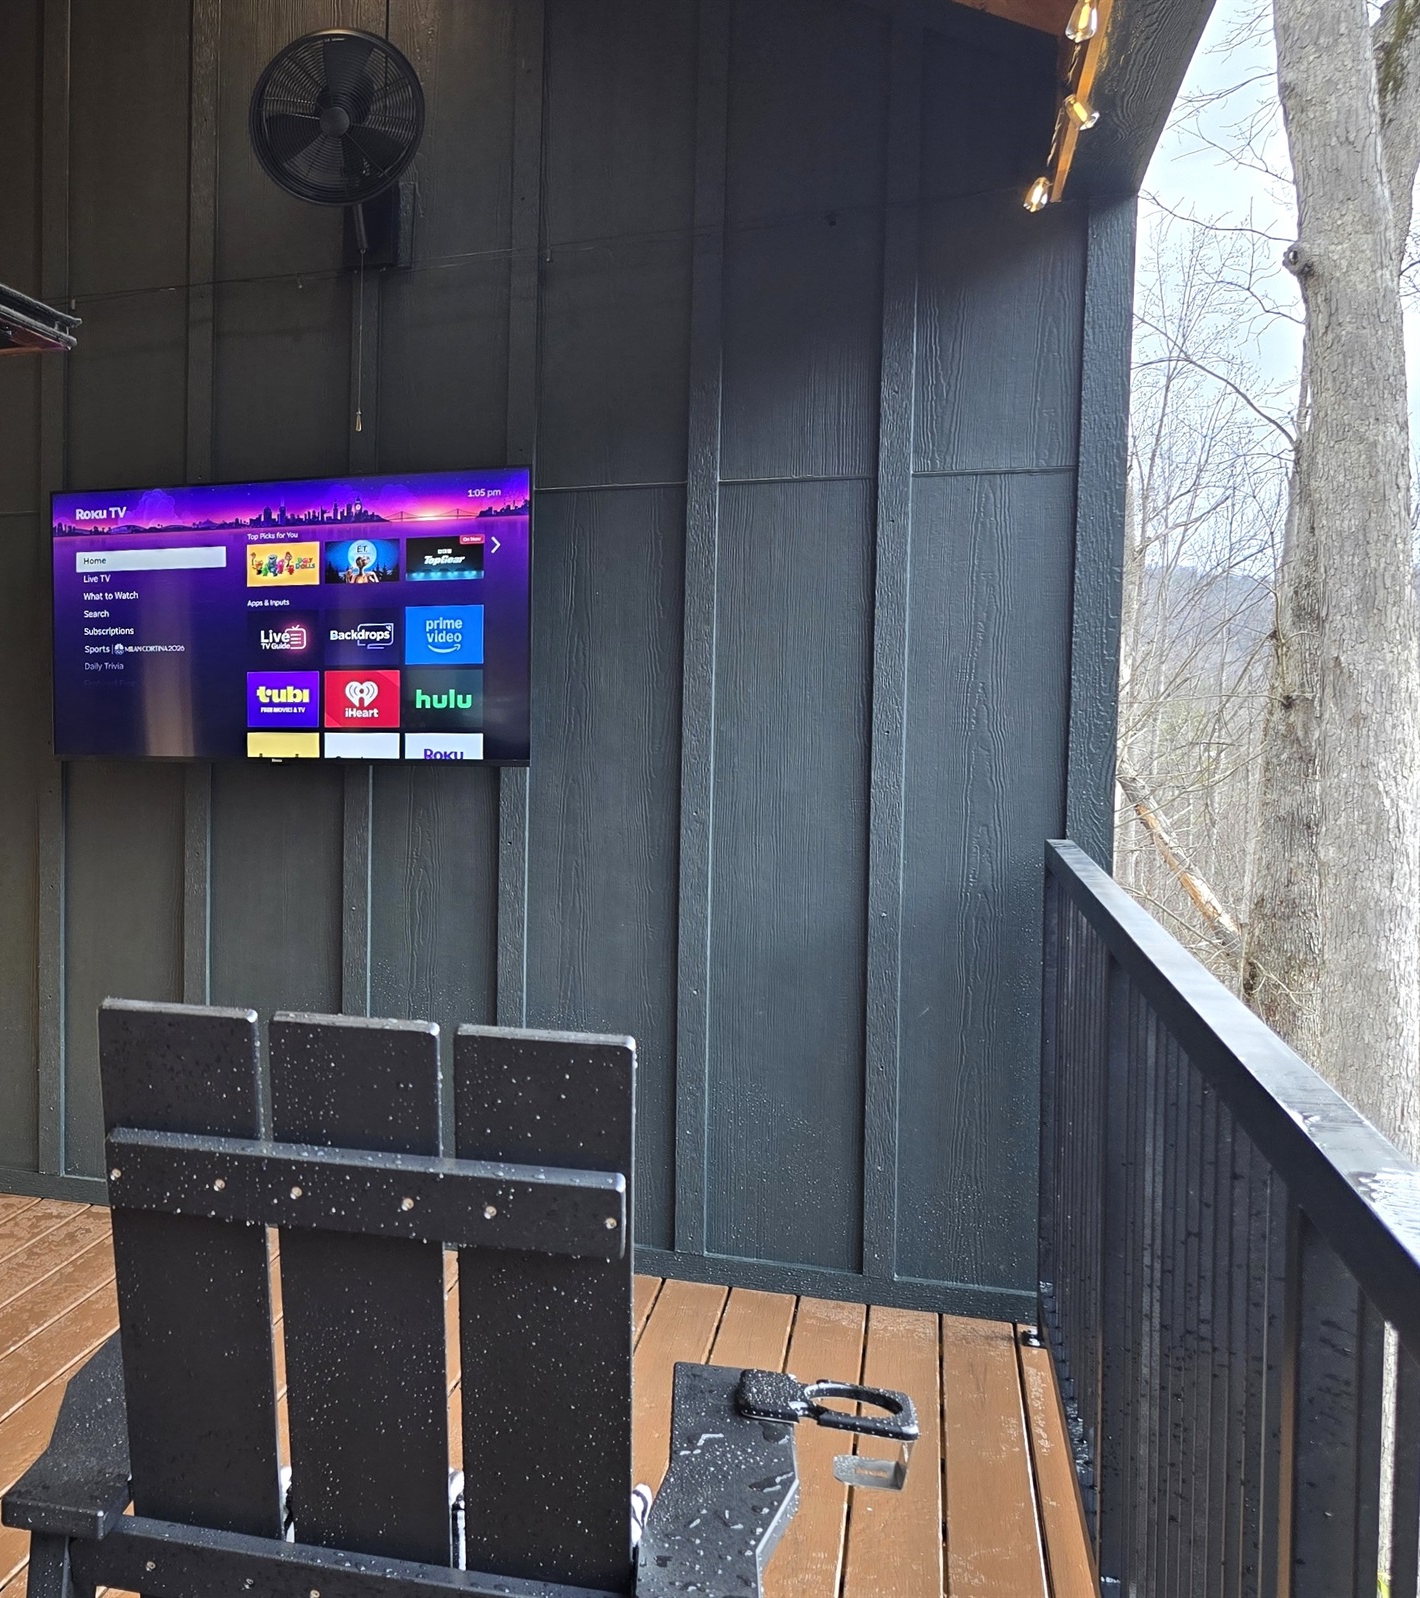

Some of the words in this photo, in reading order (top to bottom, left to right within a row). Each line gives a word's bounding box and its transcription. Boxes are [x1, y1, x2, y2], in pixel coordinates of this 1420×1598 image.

[467, 489, 486, 498] 1:05
[487, 489, 502, 498] pm
[75, 508, 107, 520] Roku
[109, 507, 127, 519] TV
[247, 533, 259, 541] Top
[83, 575, 99, 583] Live
[100, 574, 111, 582] TV
[83, 592, 103, 600] What
[105, 592, 114, 600] to
[114, 591, 139, 600] Watch
[247, 600, 263, 608] Apps
[270, 599, 290, 607] Inputs
[84, 610, 110, 618] Search
[425, 617, 463, 632] prime
[84, 627, 135, 636] Subscriptions
[330, 629, 390, 642] Backdrops
[260, 630, 291, 643] Live
[426, 630, 462, 643] video
[84, 645, 110, 654] Sports
[84, 662, 102, 671] Daily
[104, 662, 124, 670] Trivia
[256, 686, 310, 703] tubi
[416, 689, 472, 709] hulu
[345, 708, 379, 718] iHeart
